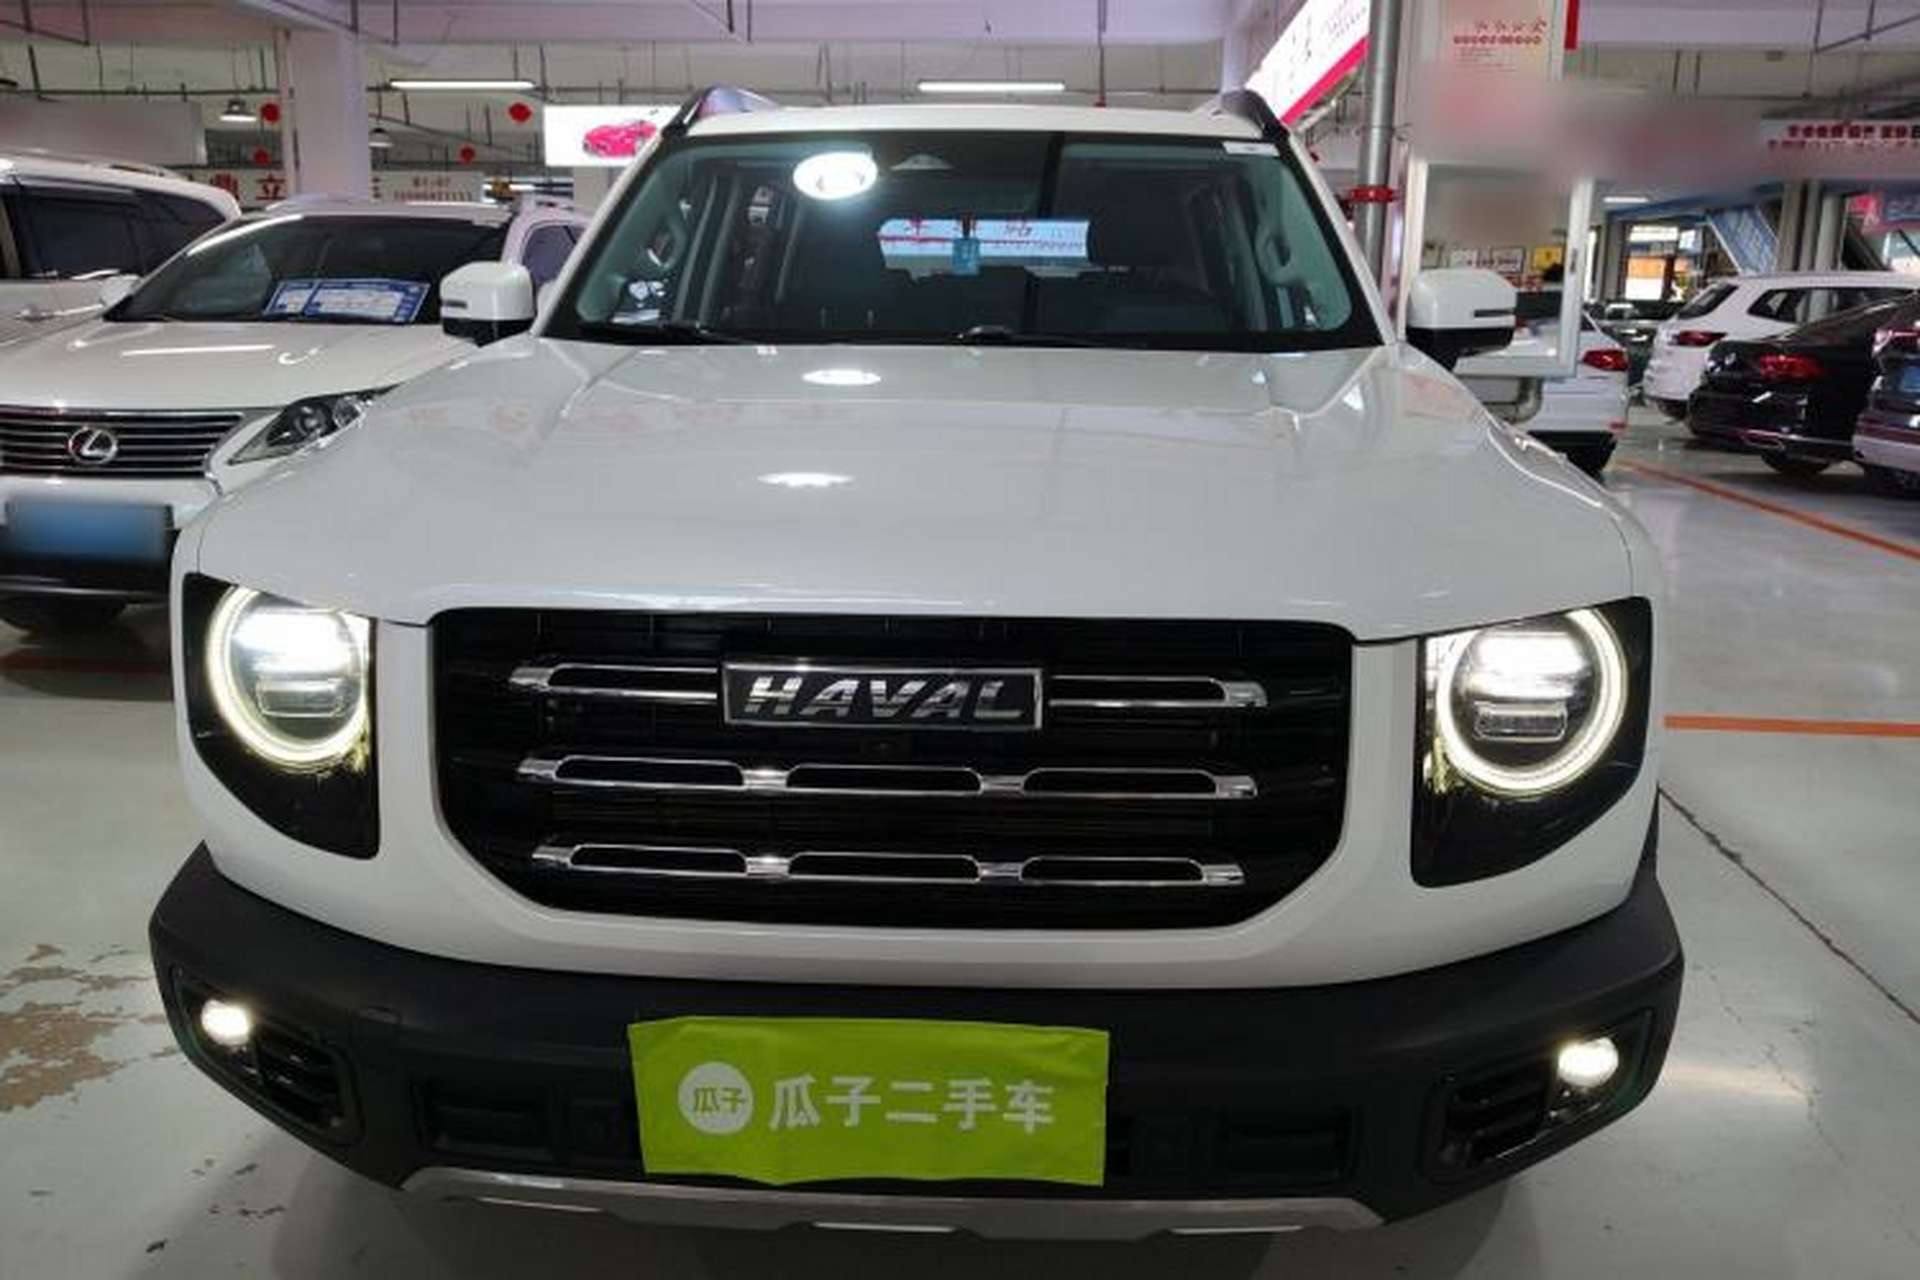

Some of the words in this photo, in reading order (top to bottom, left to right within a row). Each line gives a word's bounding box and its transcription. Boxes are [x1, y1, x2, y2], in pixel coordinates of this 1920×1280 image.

[743, 675, 1023, 719] HAVAL
[694, 1086, 746, 1115] 瓜子
[768, 1074, 1055, 1134] 瓜子二手车
